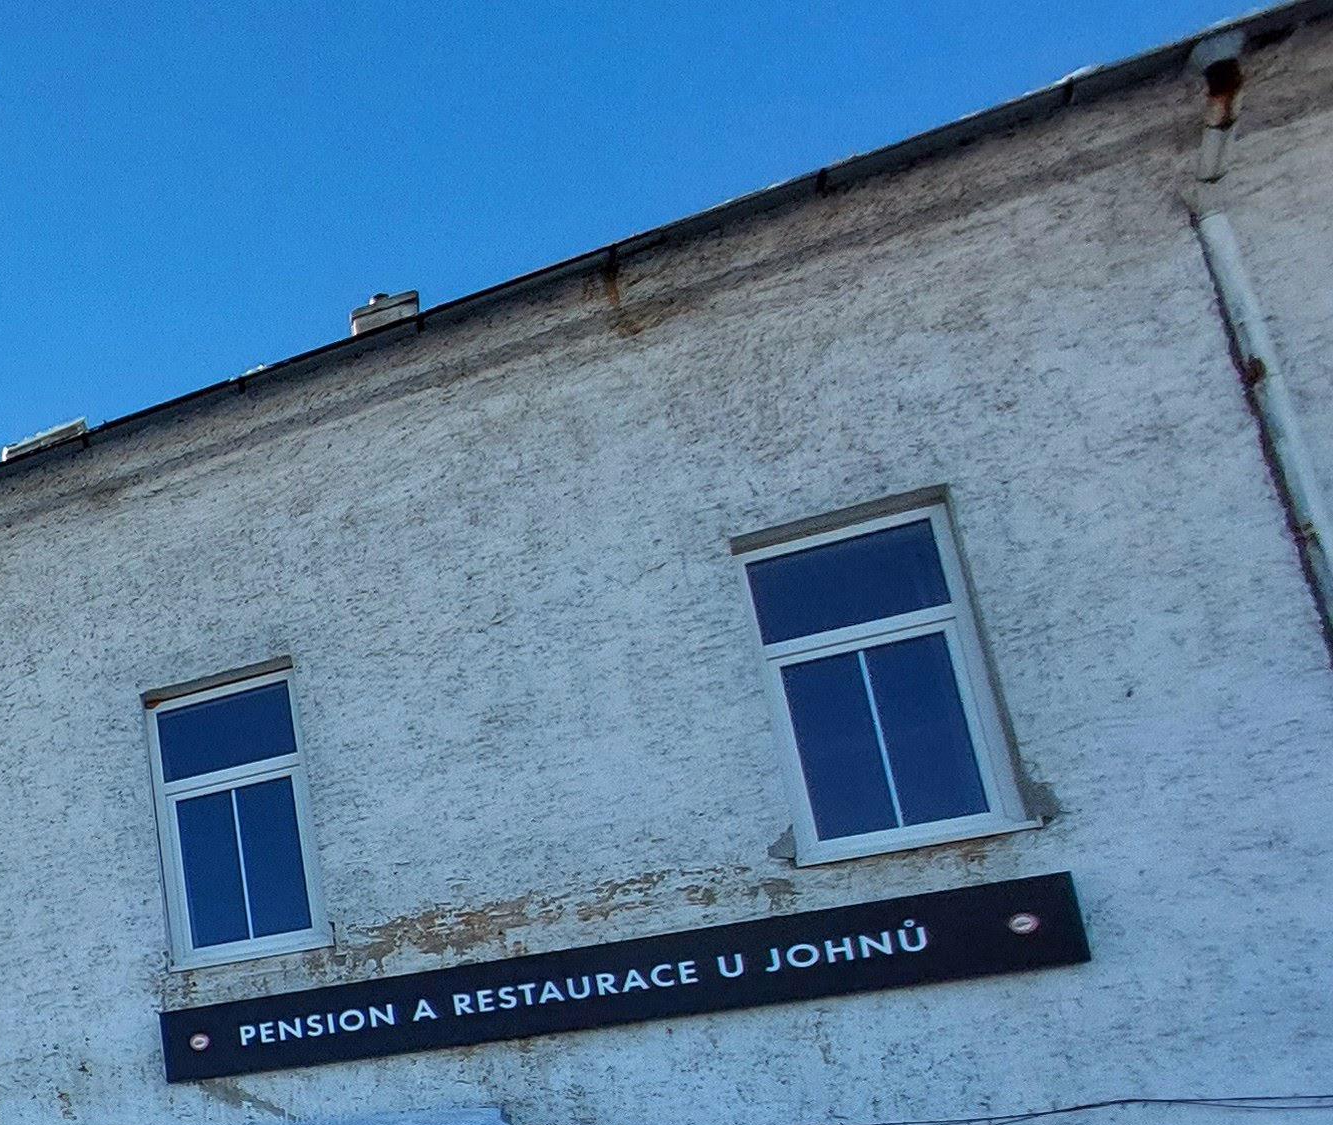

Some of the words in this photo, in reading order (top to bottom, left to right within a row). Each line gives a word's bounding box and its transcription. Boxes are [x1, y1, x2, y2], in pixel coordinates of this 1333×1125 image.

[239, 1003, 395, 1046] PENSION
[412, 999, 438, 1022] A
[452, 960, 699, 1016] RESTAURACE
[716, 953, 745, 978] U
[765, 918, 929, 972] JOHNŮ
